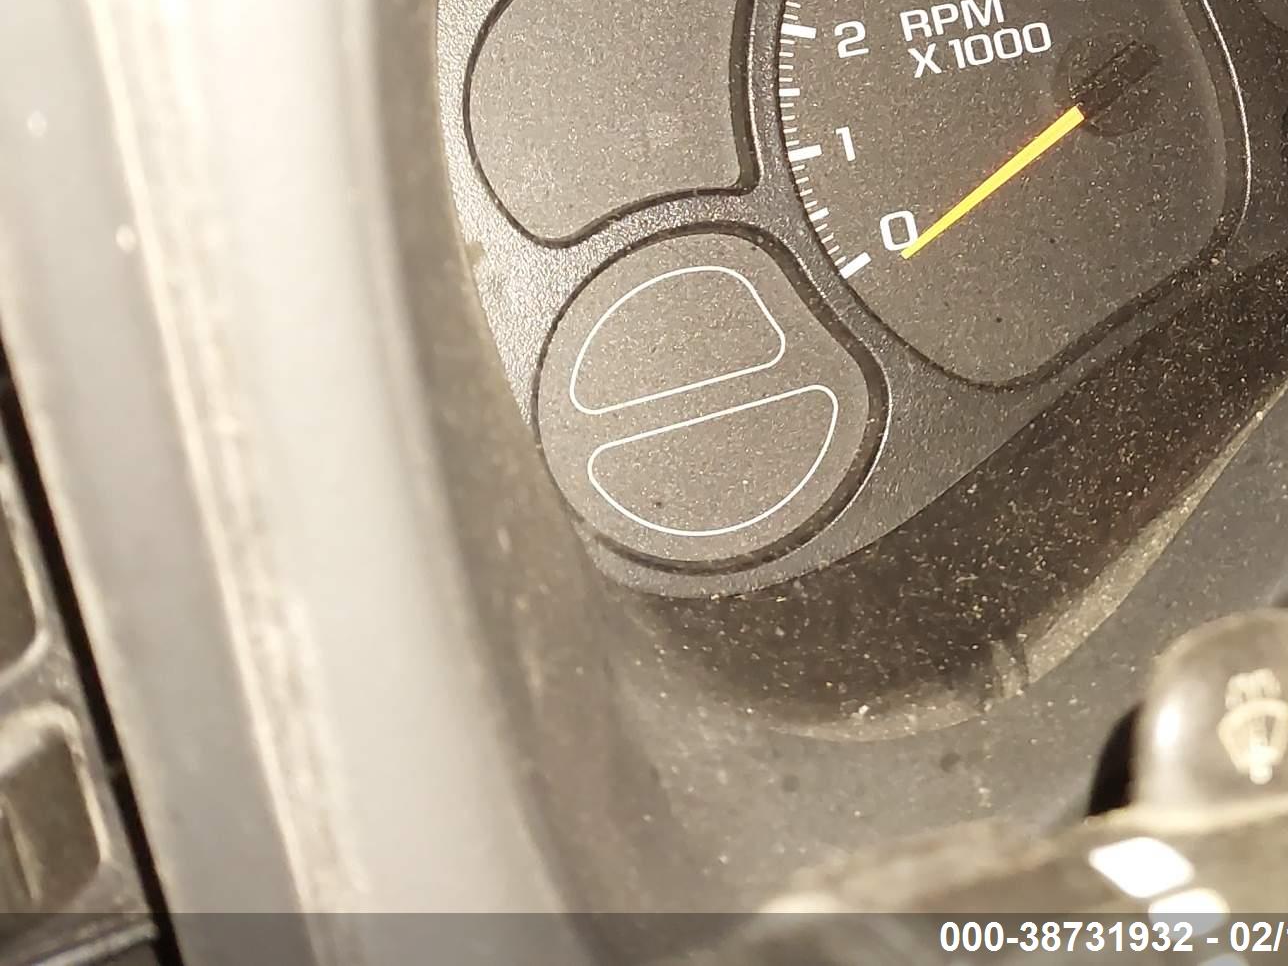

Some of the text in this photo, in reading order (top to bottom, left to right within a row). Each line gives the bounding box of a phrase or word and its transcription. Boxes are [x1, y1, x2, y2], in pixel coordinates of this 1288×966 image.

[834, 20, 869, 59] 2
[907, 21, 1053, 79] X 1000
[835, 126, 856, 162] 1
[878, 209, 919, 251] 0
